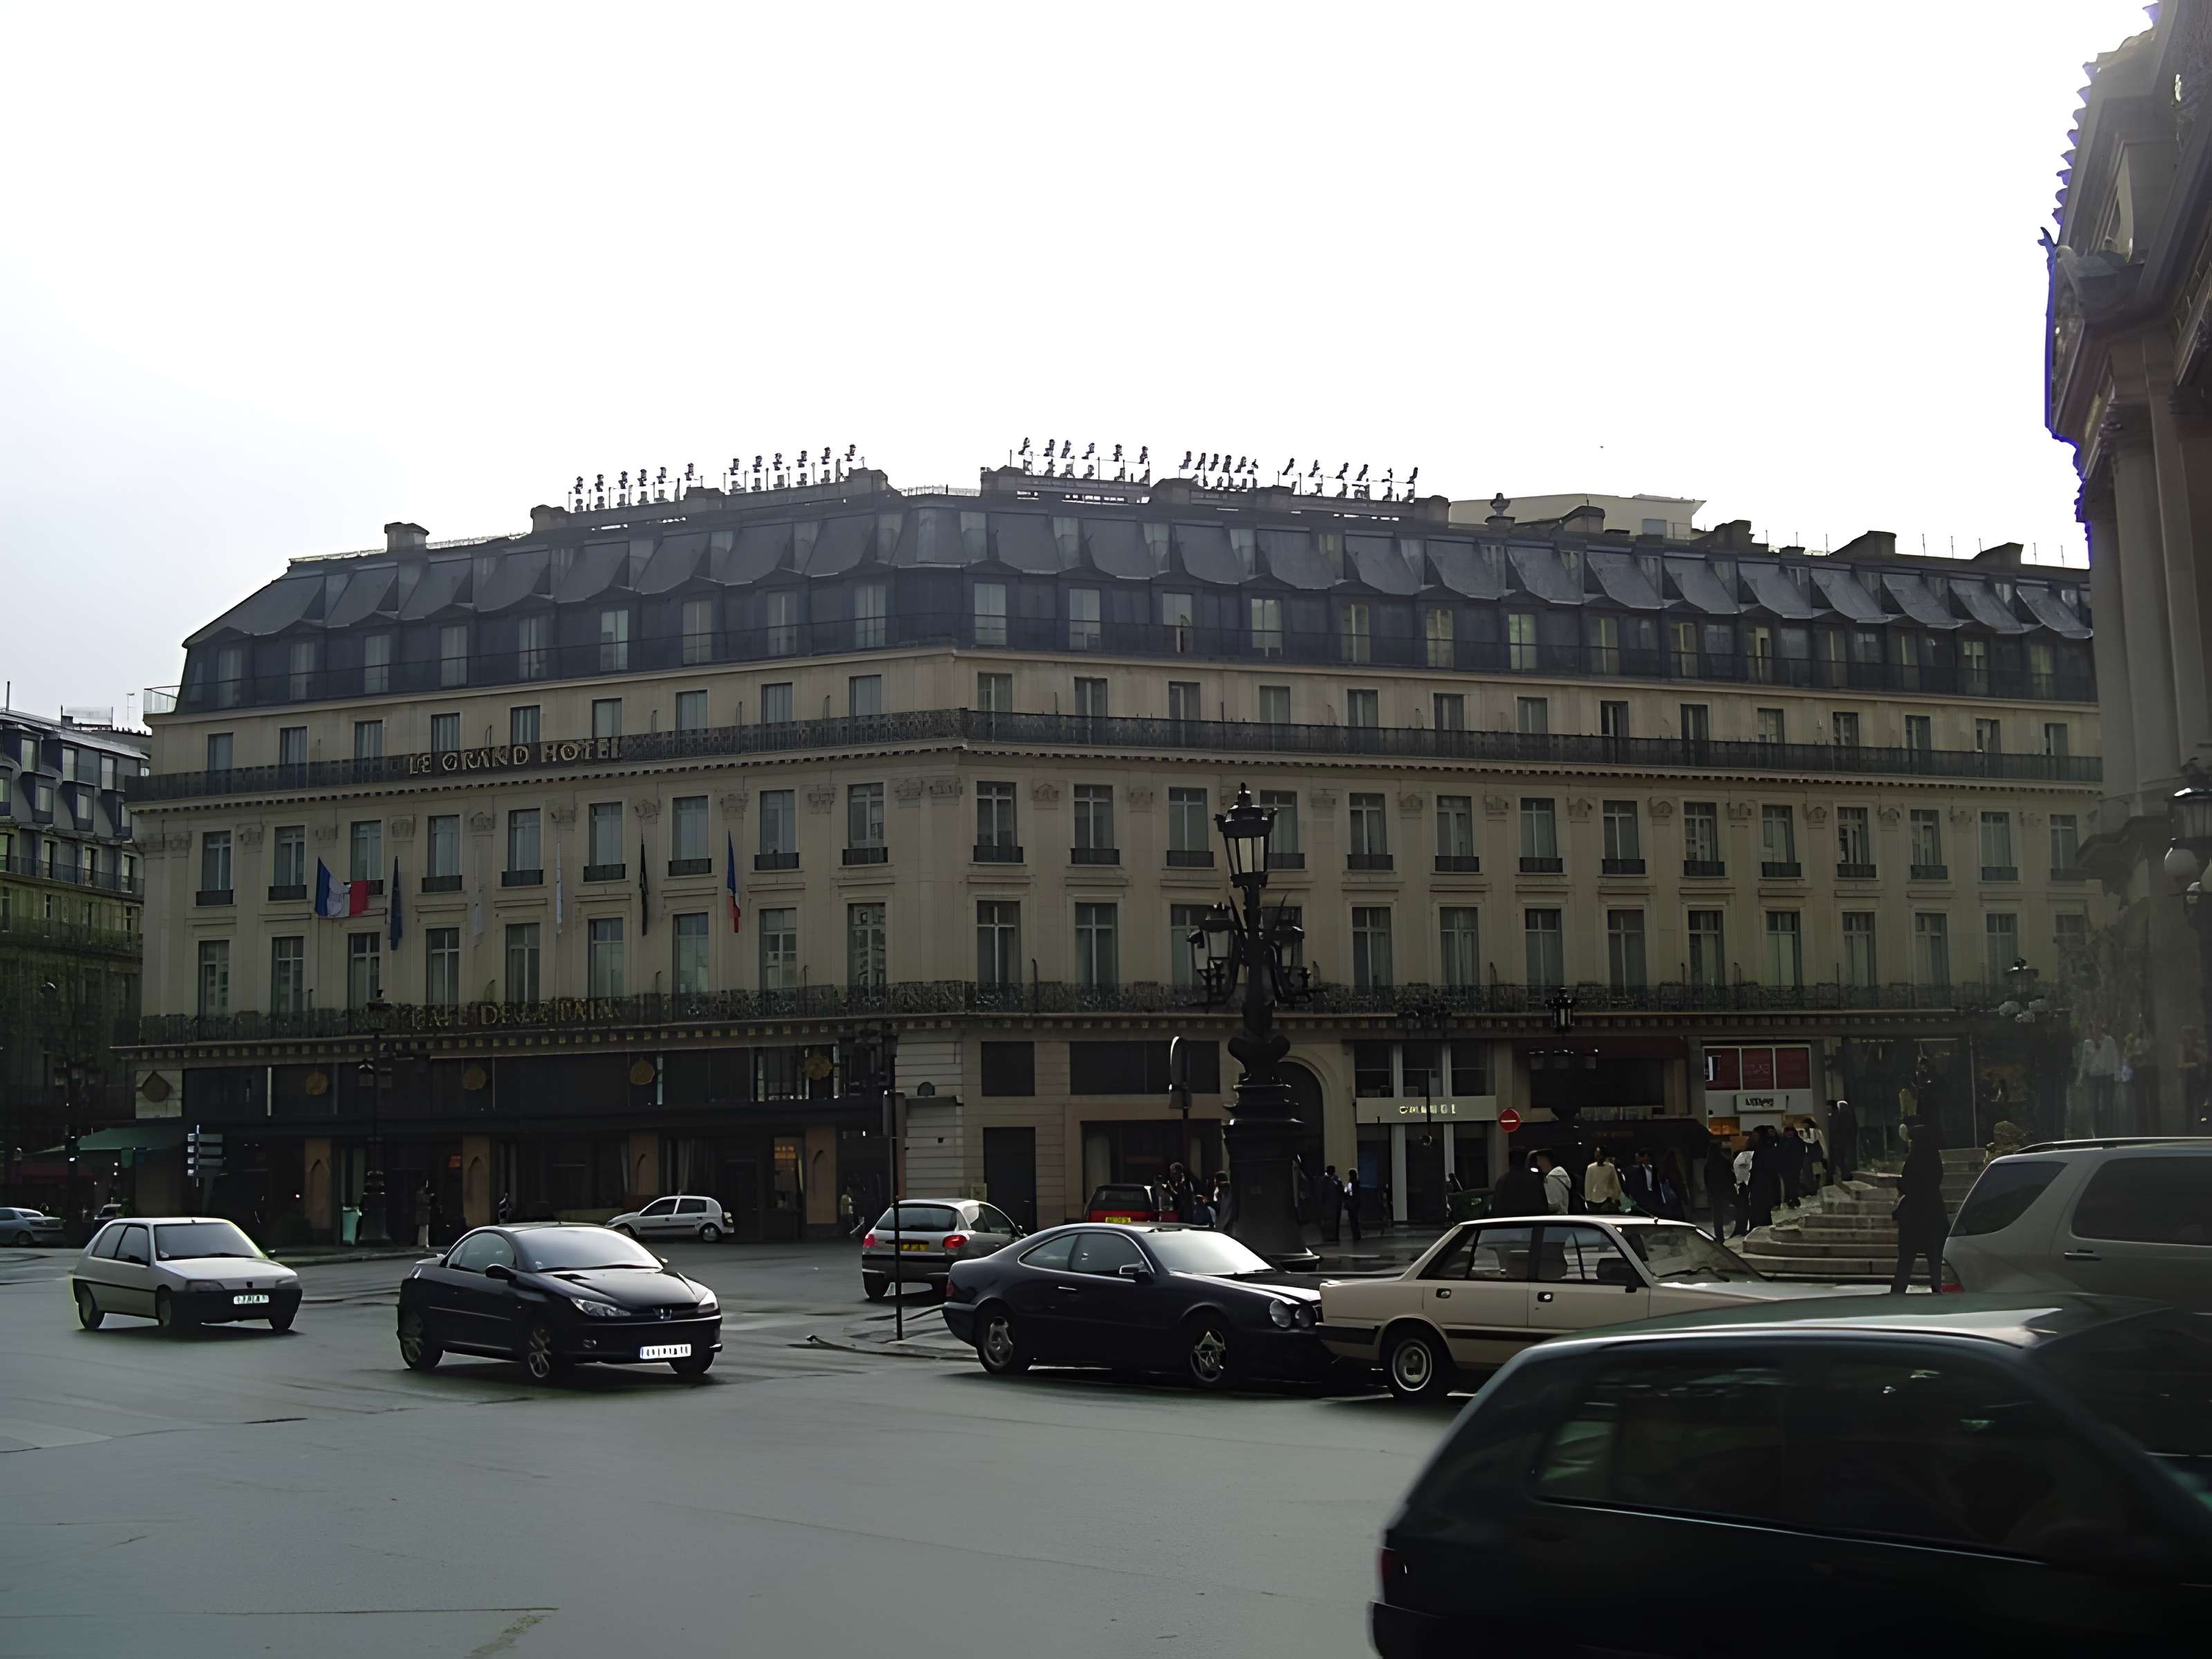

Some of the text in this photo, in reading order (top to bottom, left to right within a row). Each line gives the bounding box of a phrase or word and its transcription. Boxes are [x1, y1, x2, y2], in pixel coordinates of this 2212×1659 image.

[409, 737, 621, 775] LE GRAND HOTEL
